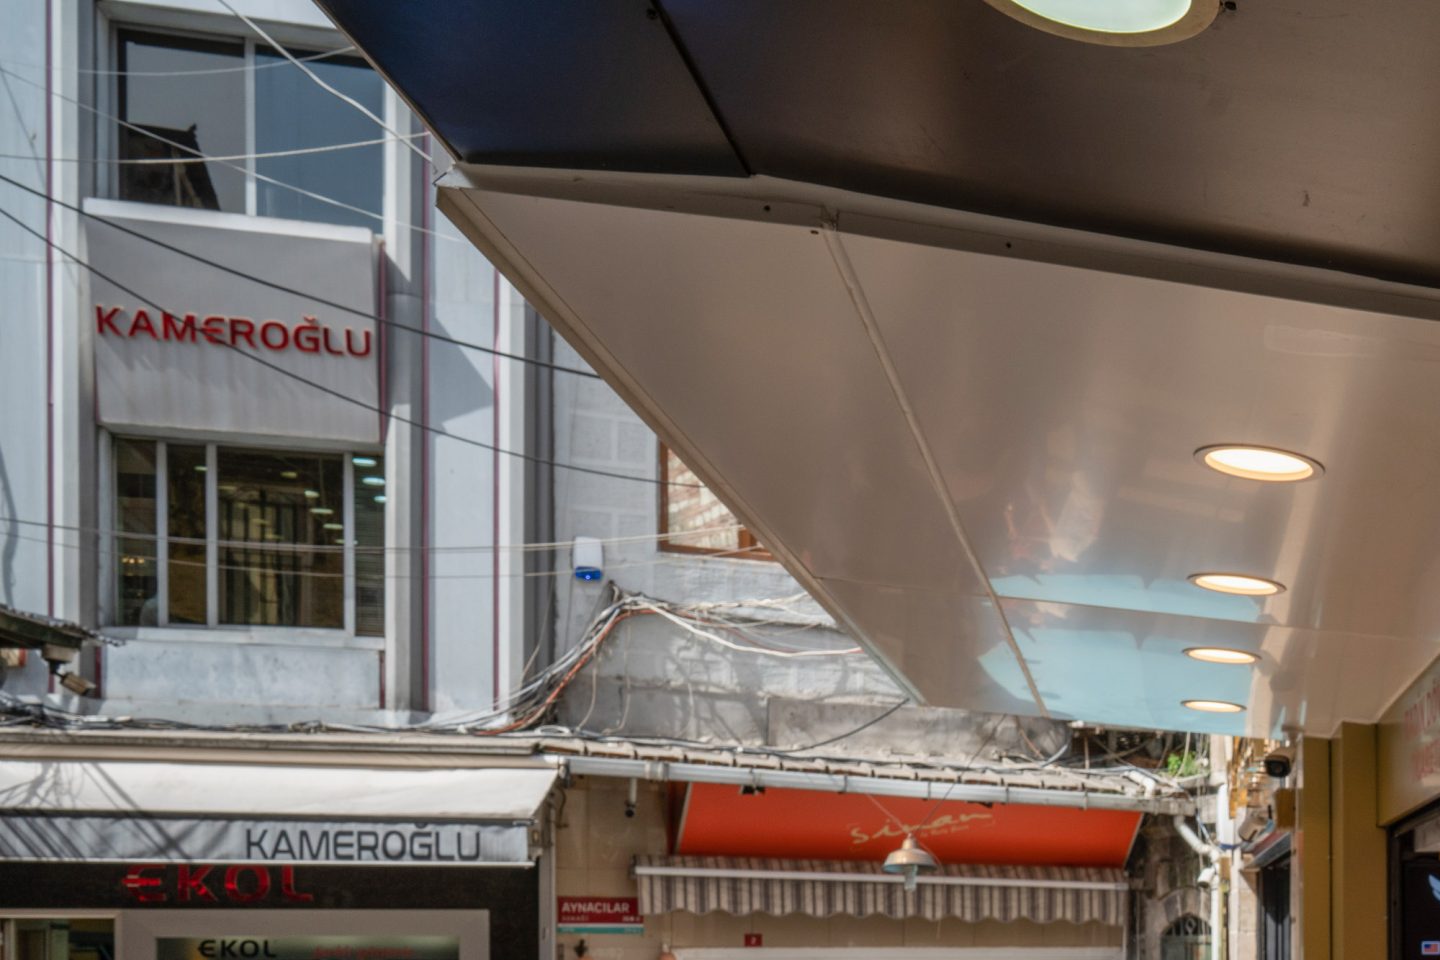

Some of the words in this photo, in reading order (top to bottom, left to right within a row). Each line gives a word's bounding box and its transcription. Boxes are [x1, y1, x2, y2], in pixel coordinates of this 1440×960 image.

[96, 306, 372, 358] KAMEROĞLU
[246, 822, 481, 861] KAMEROĞLU
[121, 864, 315, 901] EKOL
[562, 901, 631, 914] AYNACILAR
[197, 939, 278, 958] EKOL
